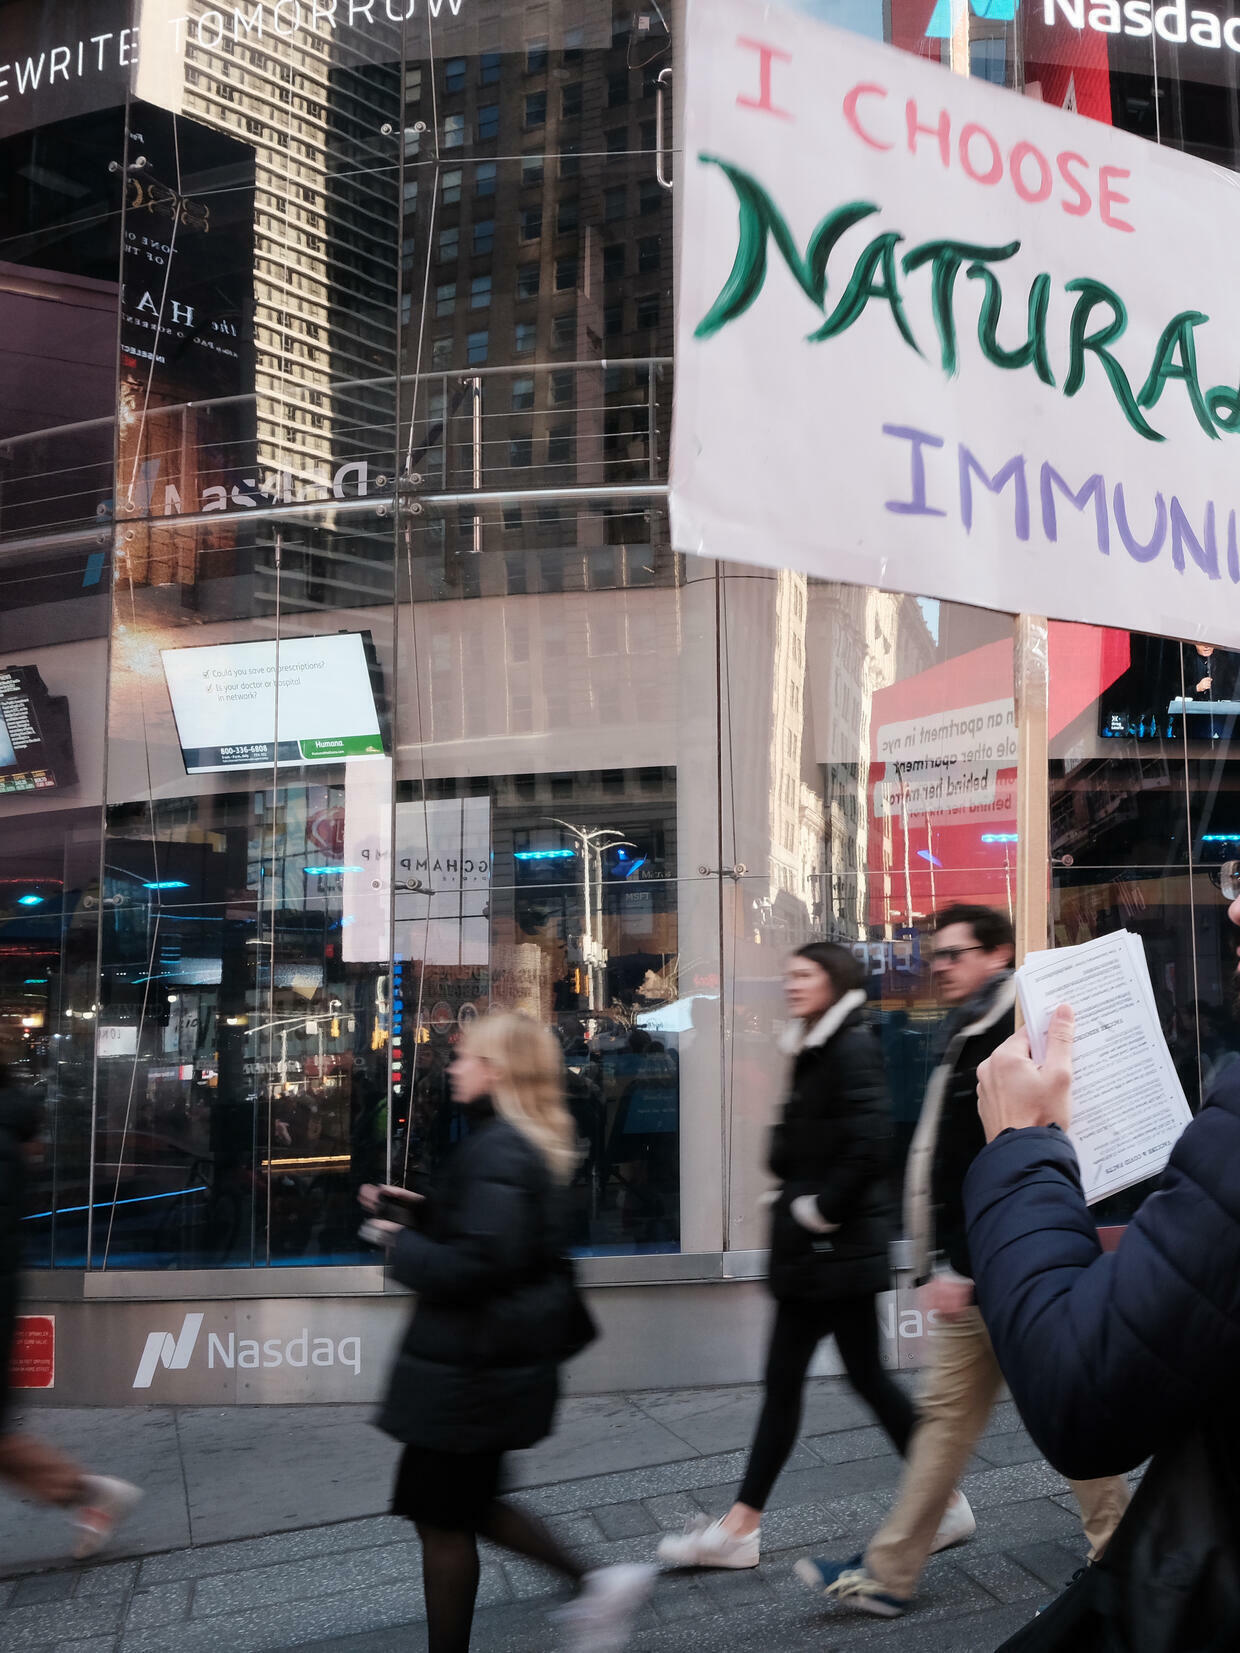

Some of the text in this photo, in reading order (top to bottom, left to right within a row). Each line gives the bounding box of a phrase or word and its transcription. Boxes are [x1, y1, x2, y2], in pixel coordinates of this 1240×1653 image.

[735, 34, 1136, 233] I CHOOSE
[240, 680, 263, 690] doctor
[207, 1328, 362, 1376] Nasdaq
